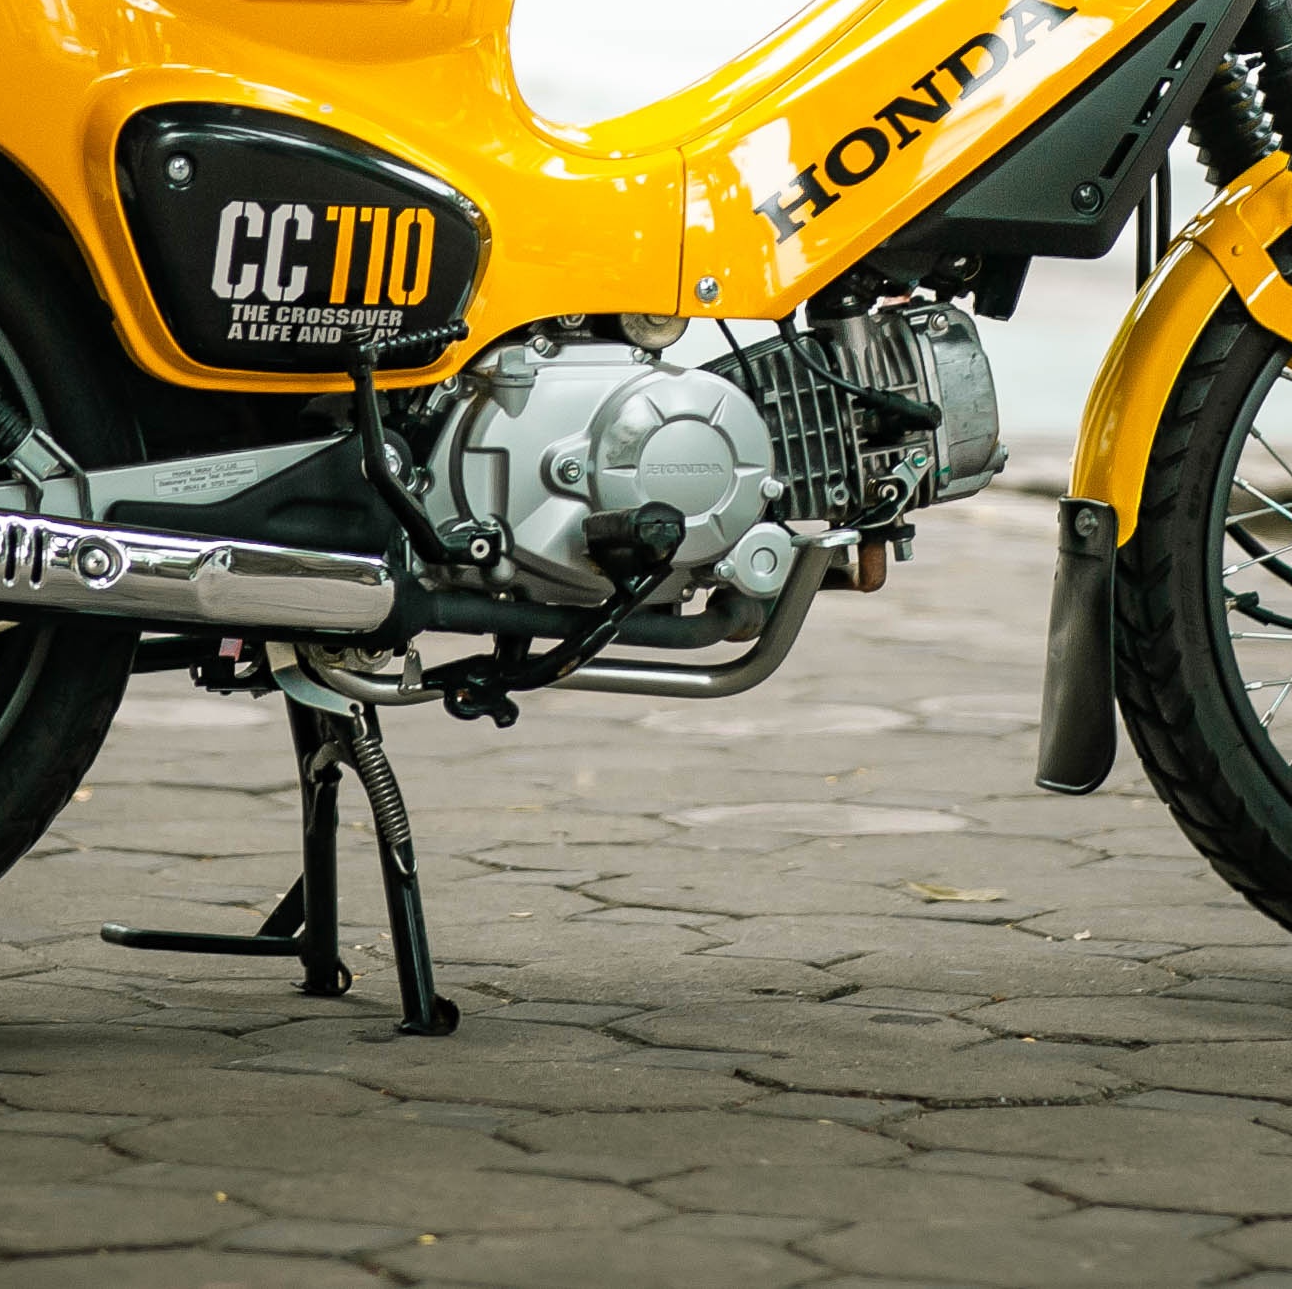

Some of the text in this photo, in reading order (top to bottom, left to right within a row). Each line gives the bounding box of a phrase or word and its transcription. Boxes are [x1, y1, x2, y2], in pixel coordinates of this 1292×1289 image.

[231, 304, 403, 326] THE CROSSOVER
[227, 322, 244, 341] A
[248, 324, 293, 343] LIFE
[296, 327, 342, 344] AND
[646, 462, 725, 478] HONDA
